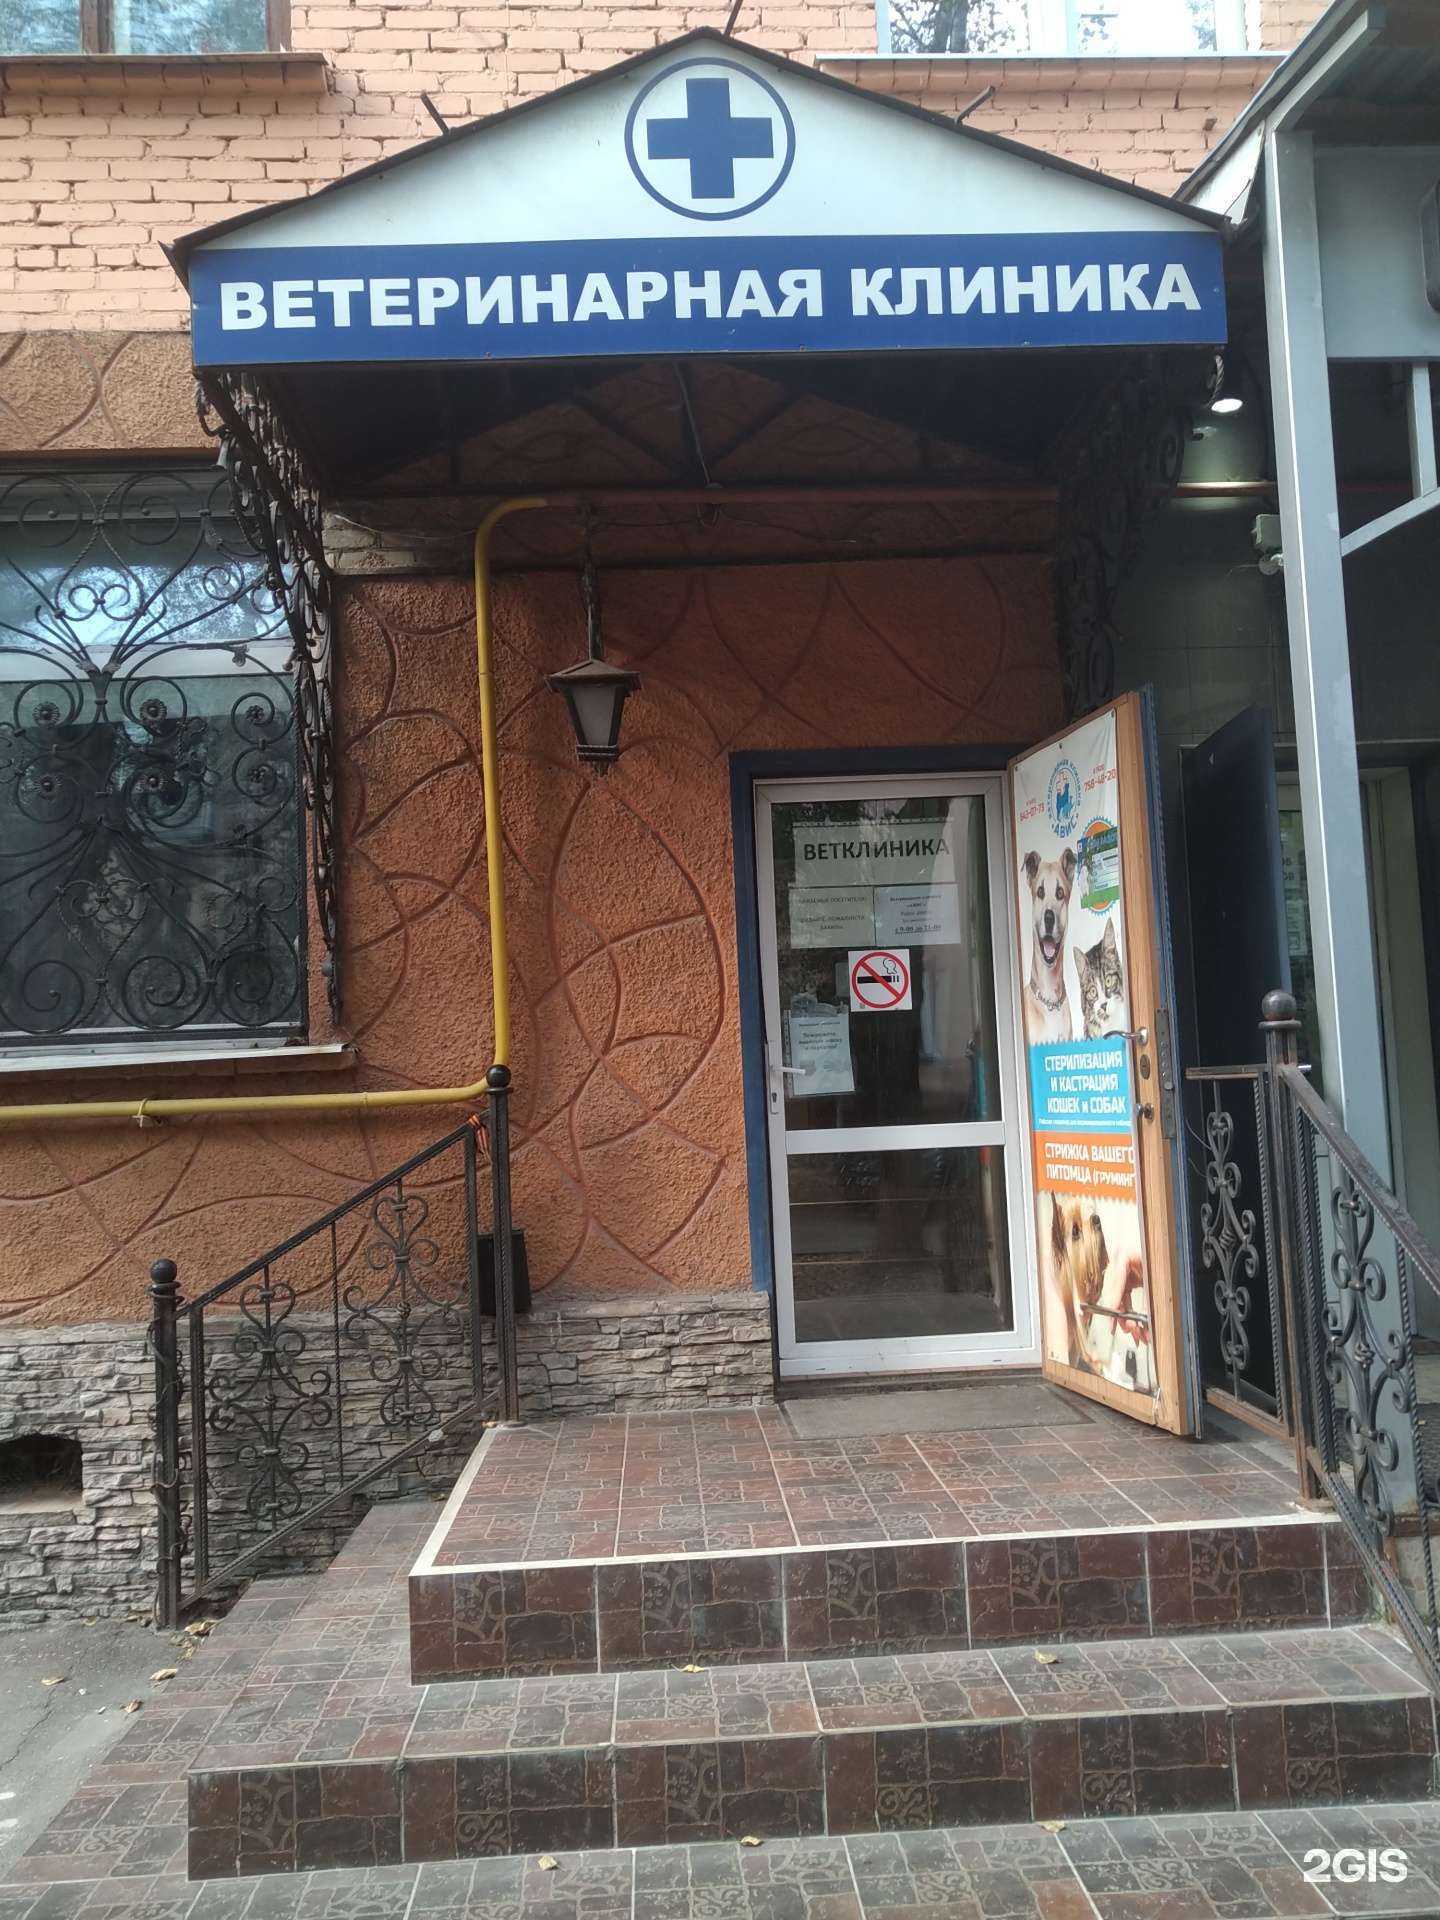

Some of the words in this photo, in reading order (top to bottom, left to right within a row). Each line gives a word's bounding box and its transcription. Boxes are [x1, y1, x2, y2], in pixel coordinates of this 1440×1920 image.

[220, 268, 824, 332] ВЕТЕРИНАРНАЯ
[850, 263, 1202, 317] КЛИНИКА
[804, 839, 950, 861] ВЕТКЛИНИКА
[1044, 1051, 1123, 1071] СТЕРИЛИЗАЦИЯ
[1050, 1077, 1058, 1092] И
[1059, 1074, 1119, 1093] КАСТРАЦИЯ
[1047, 1097, 1080, 1114] КОШЕК
[1089, 1096, 1127, 1114] СОБАК
[1044, 1142, 1090, 1160] СТРИЖКА
[1045, 1163, 1092, 1184] ПИТОМЦА
